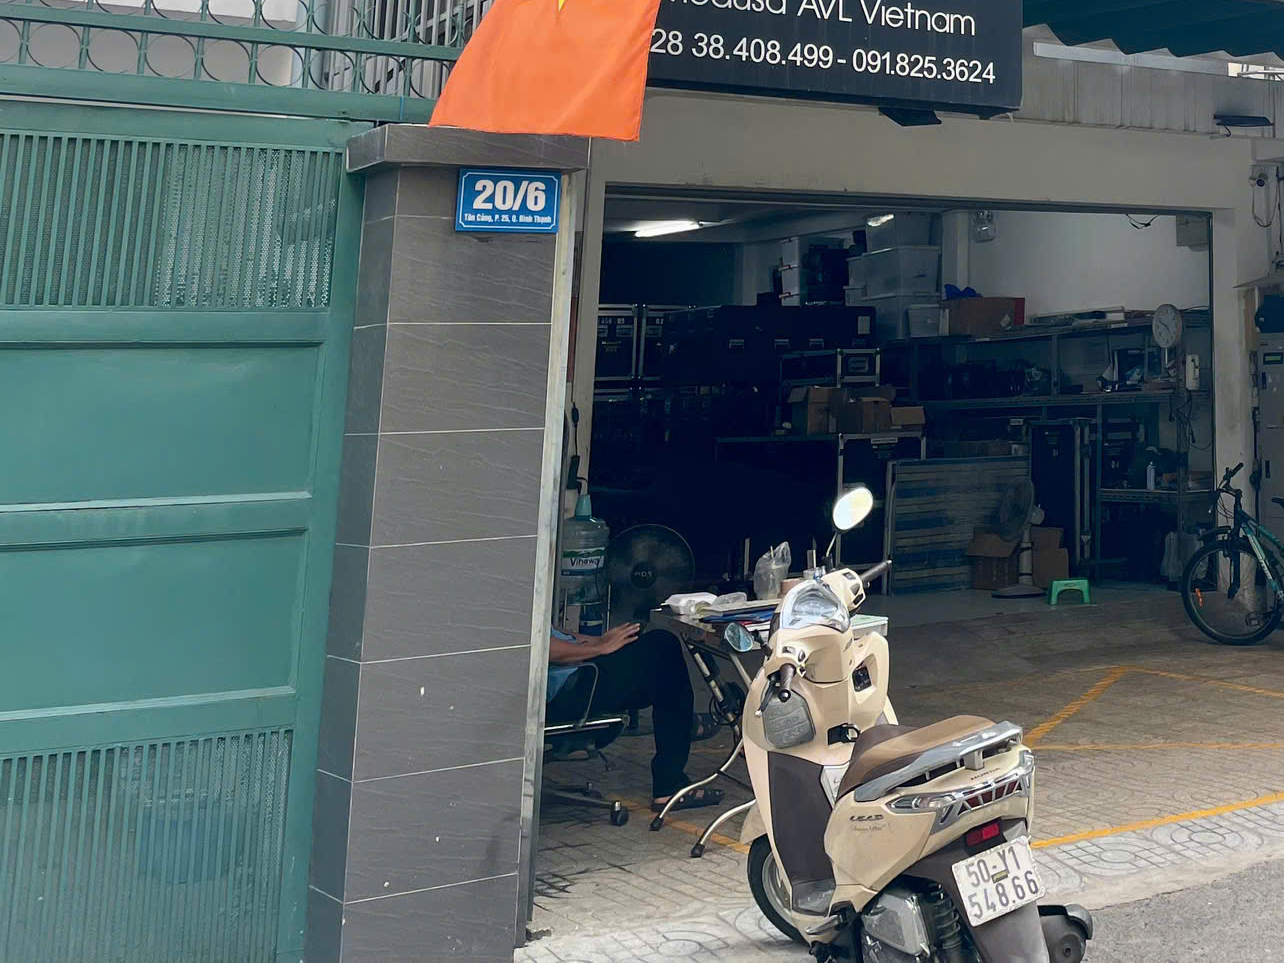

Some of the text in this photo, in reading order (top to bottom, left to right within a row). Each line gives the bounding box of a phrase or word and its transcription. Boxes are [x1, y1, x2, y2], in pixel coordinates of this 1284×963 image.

[473, 179, 546, 212] 20/6
[965, 846, 1021, 887] 50-Y1
[968, 871, 1039, 918] 548.66
